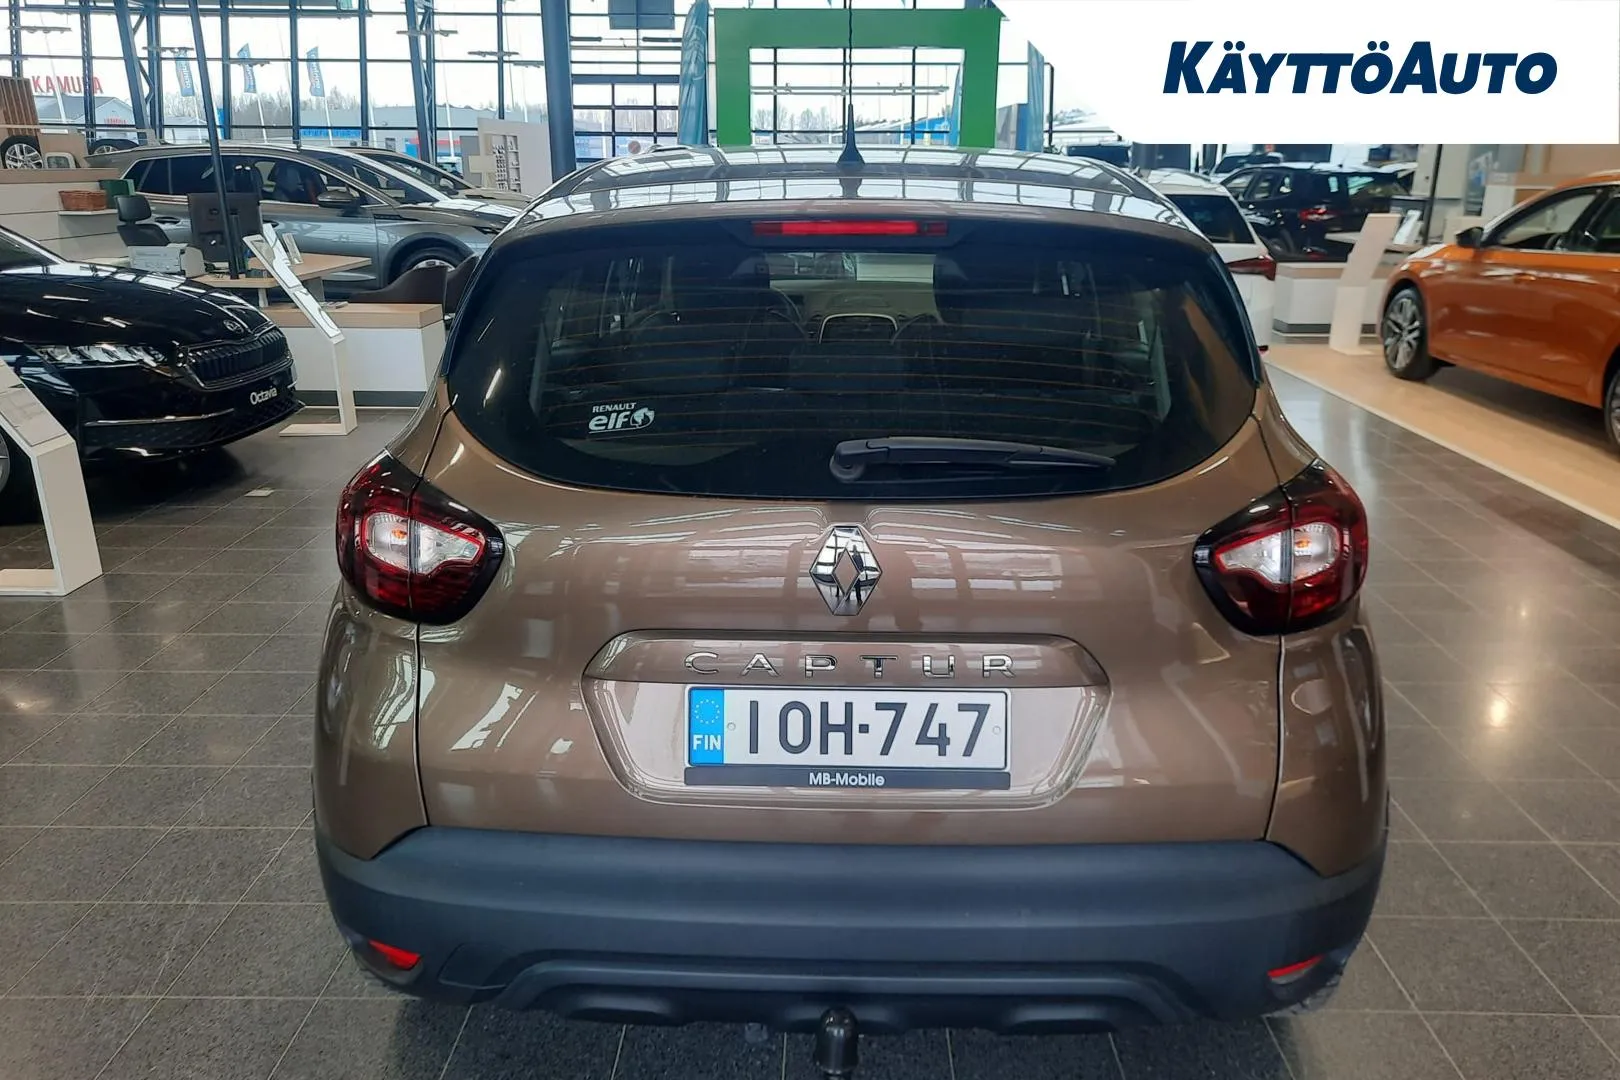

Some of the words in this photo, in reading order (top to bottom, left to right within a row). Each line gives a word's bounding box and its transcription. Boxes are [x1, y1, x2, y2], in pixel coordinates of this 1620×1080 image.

[249, 385, 278, 405] Octavia
[592, 402, 637, 413] RENAULT
[588, 411, 631, 431] elf
[684, 651, 1016, 679] CAPTUR
[749, 700, 991, 758] IOH-747
[692, 734, 722, 751] FIN
[809, 772, 886, 787] MB-Mobile
